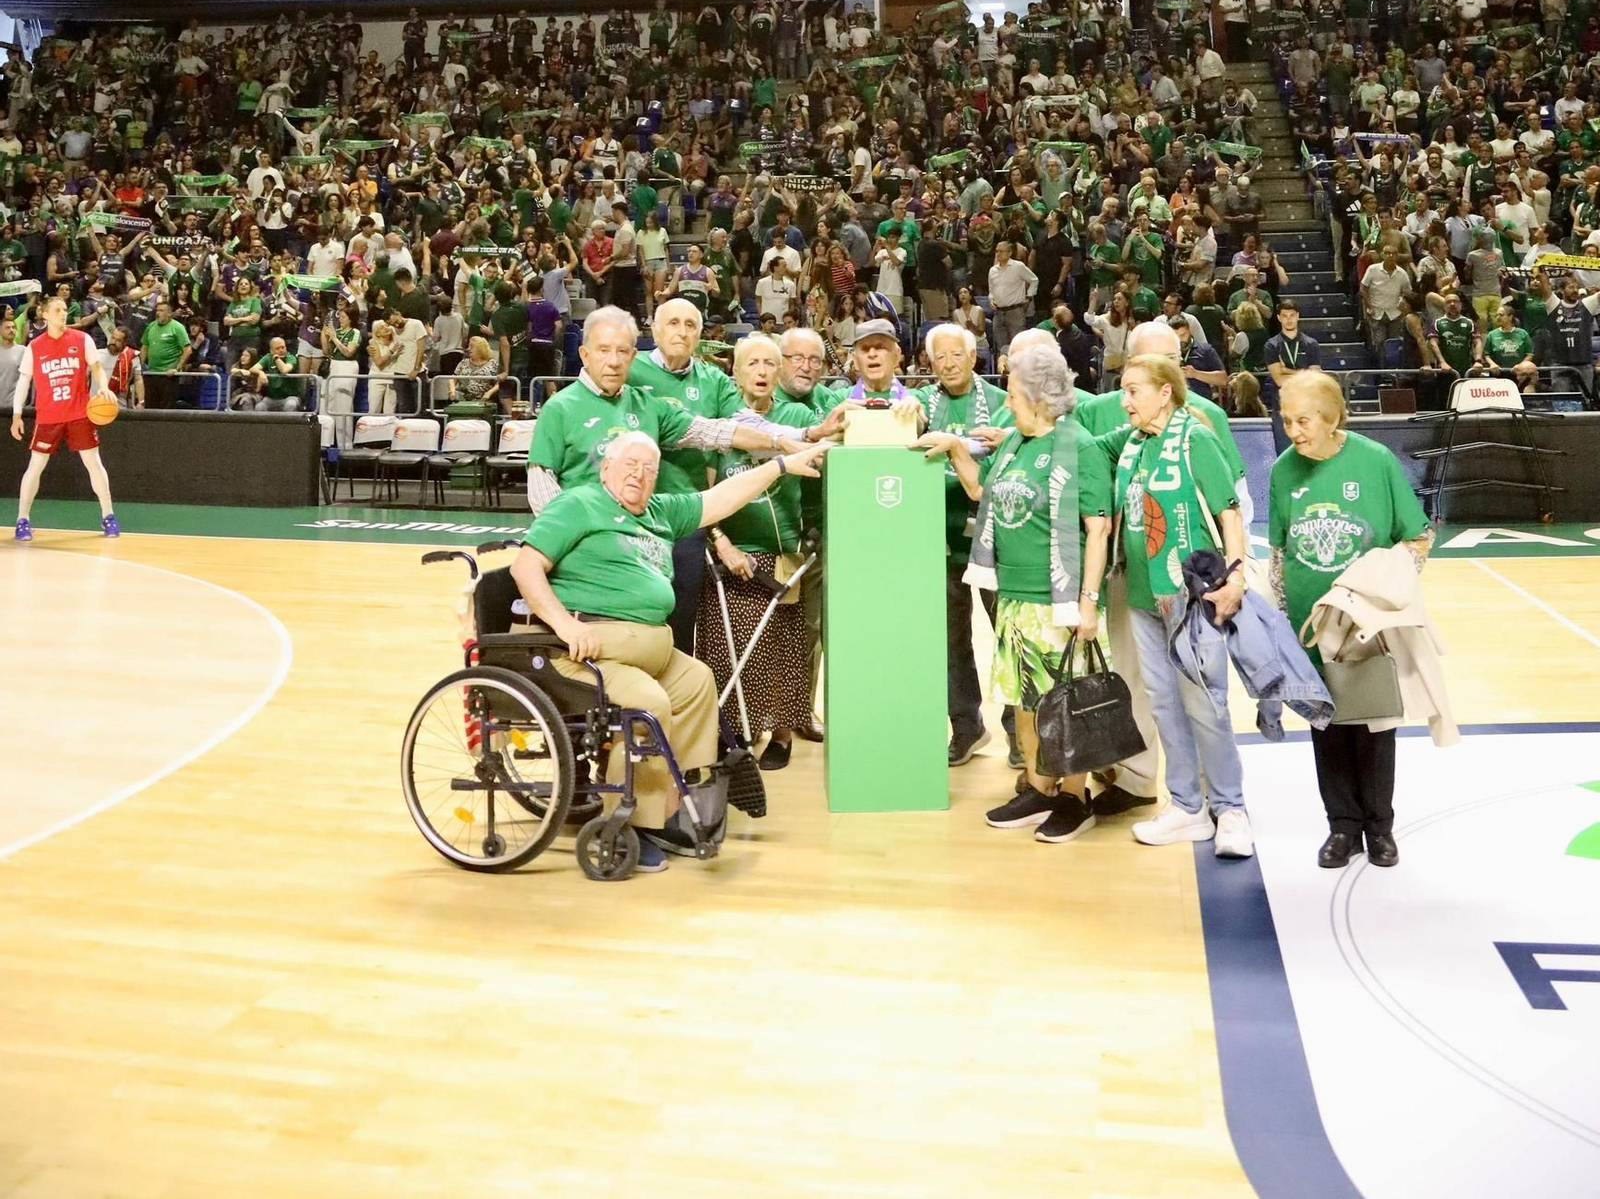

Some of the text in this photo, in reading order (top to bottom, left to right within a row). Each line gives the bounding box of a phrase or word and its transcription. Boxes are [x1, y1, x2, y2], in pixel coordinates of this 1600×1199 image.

[1566, 337, 1575, 347] 11
[41, 357, 80, 374] UCAM
[52, 385, 71, 401] 22
[1470, 387, 1510, 399] Wilson
[1173, 503, 1189, 549] Unicaja
[1290, 517, 1364, 538] Campeones
